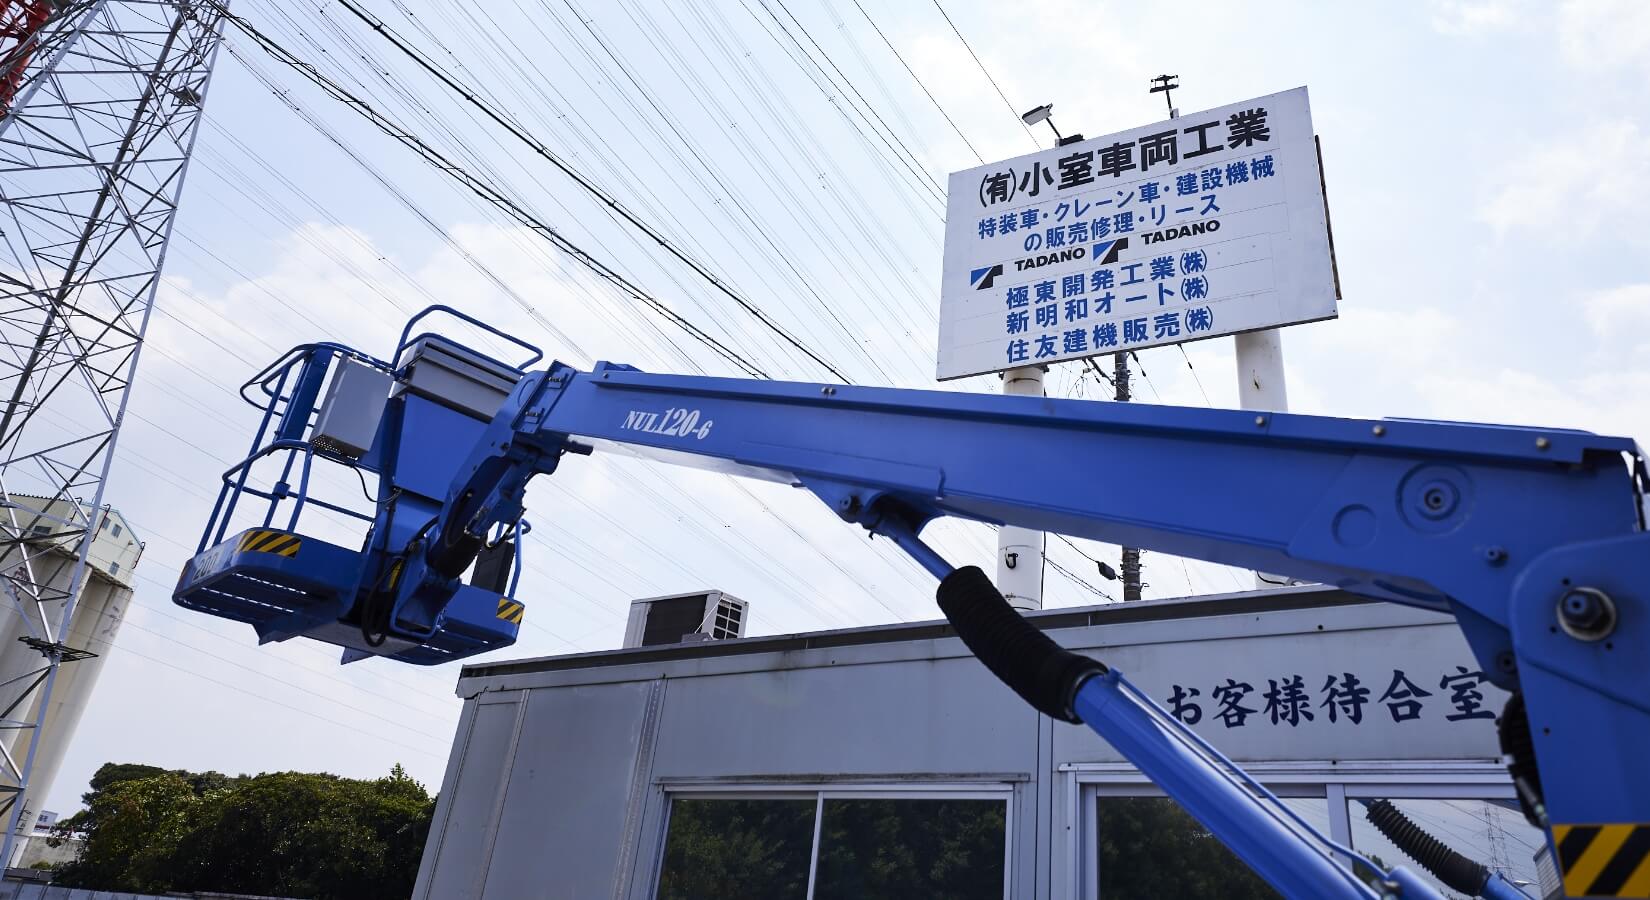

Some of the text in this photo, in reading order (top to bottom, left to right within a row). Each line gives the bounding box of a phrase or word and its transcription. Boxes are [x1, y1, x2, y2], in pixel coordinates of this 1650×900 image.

[978, 155, 1275, 240] 特装車・クレーン車・建設機械
[1024, 194, 1221, 252] の販売修理・リース
[1014, 247, 1086, 272] TADANO
[1140, 219, 1221, 245] TADANO
[1166, 665, 1497, 729] お客様待合室
